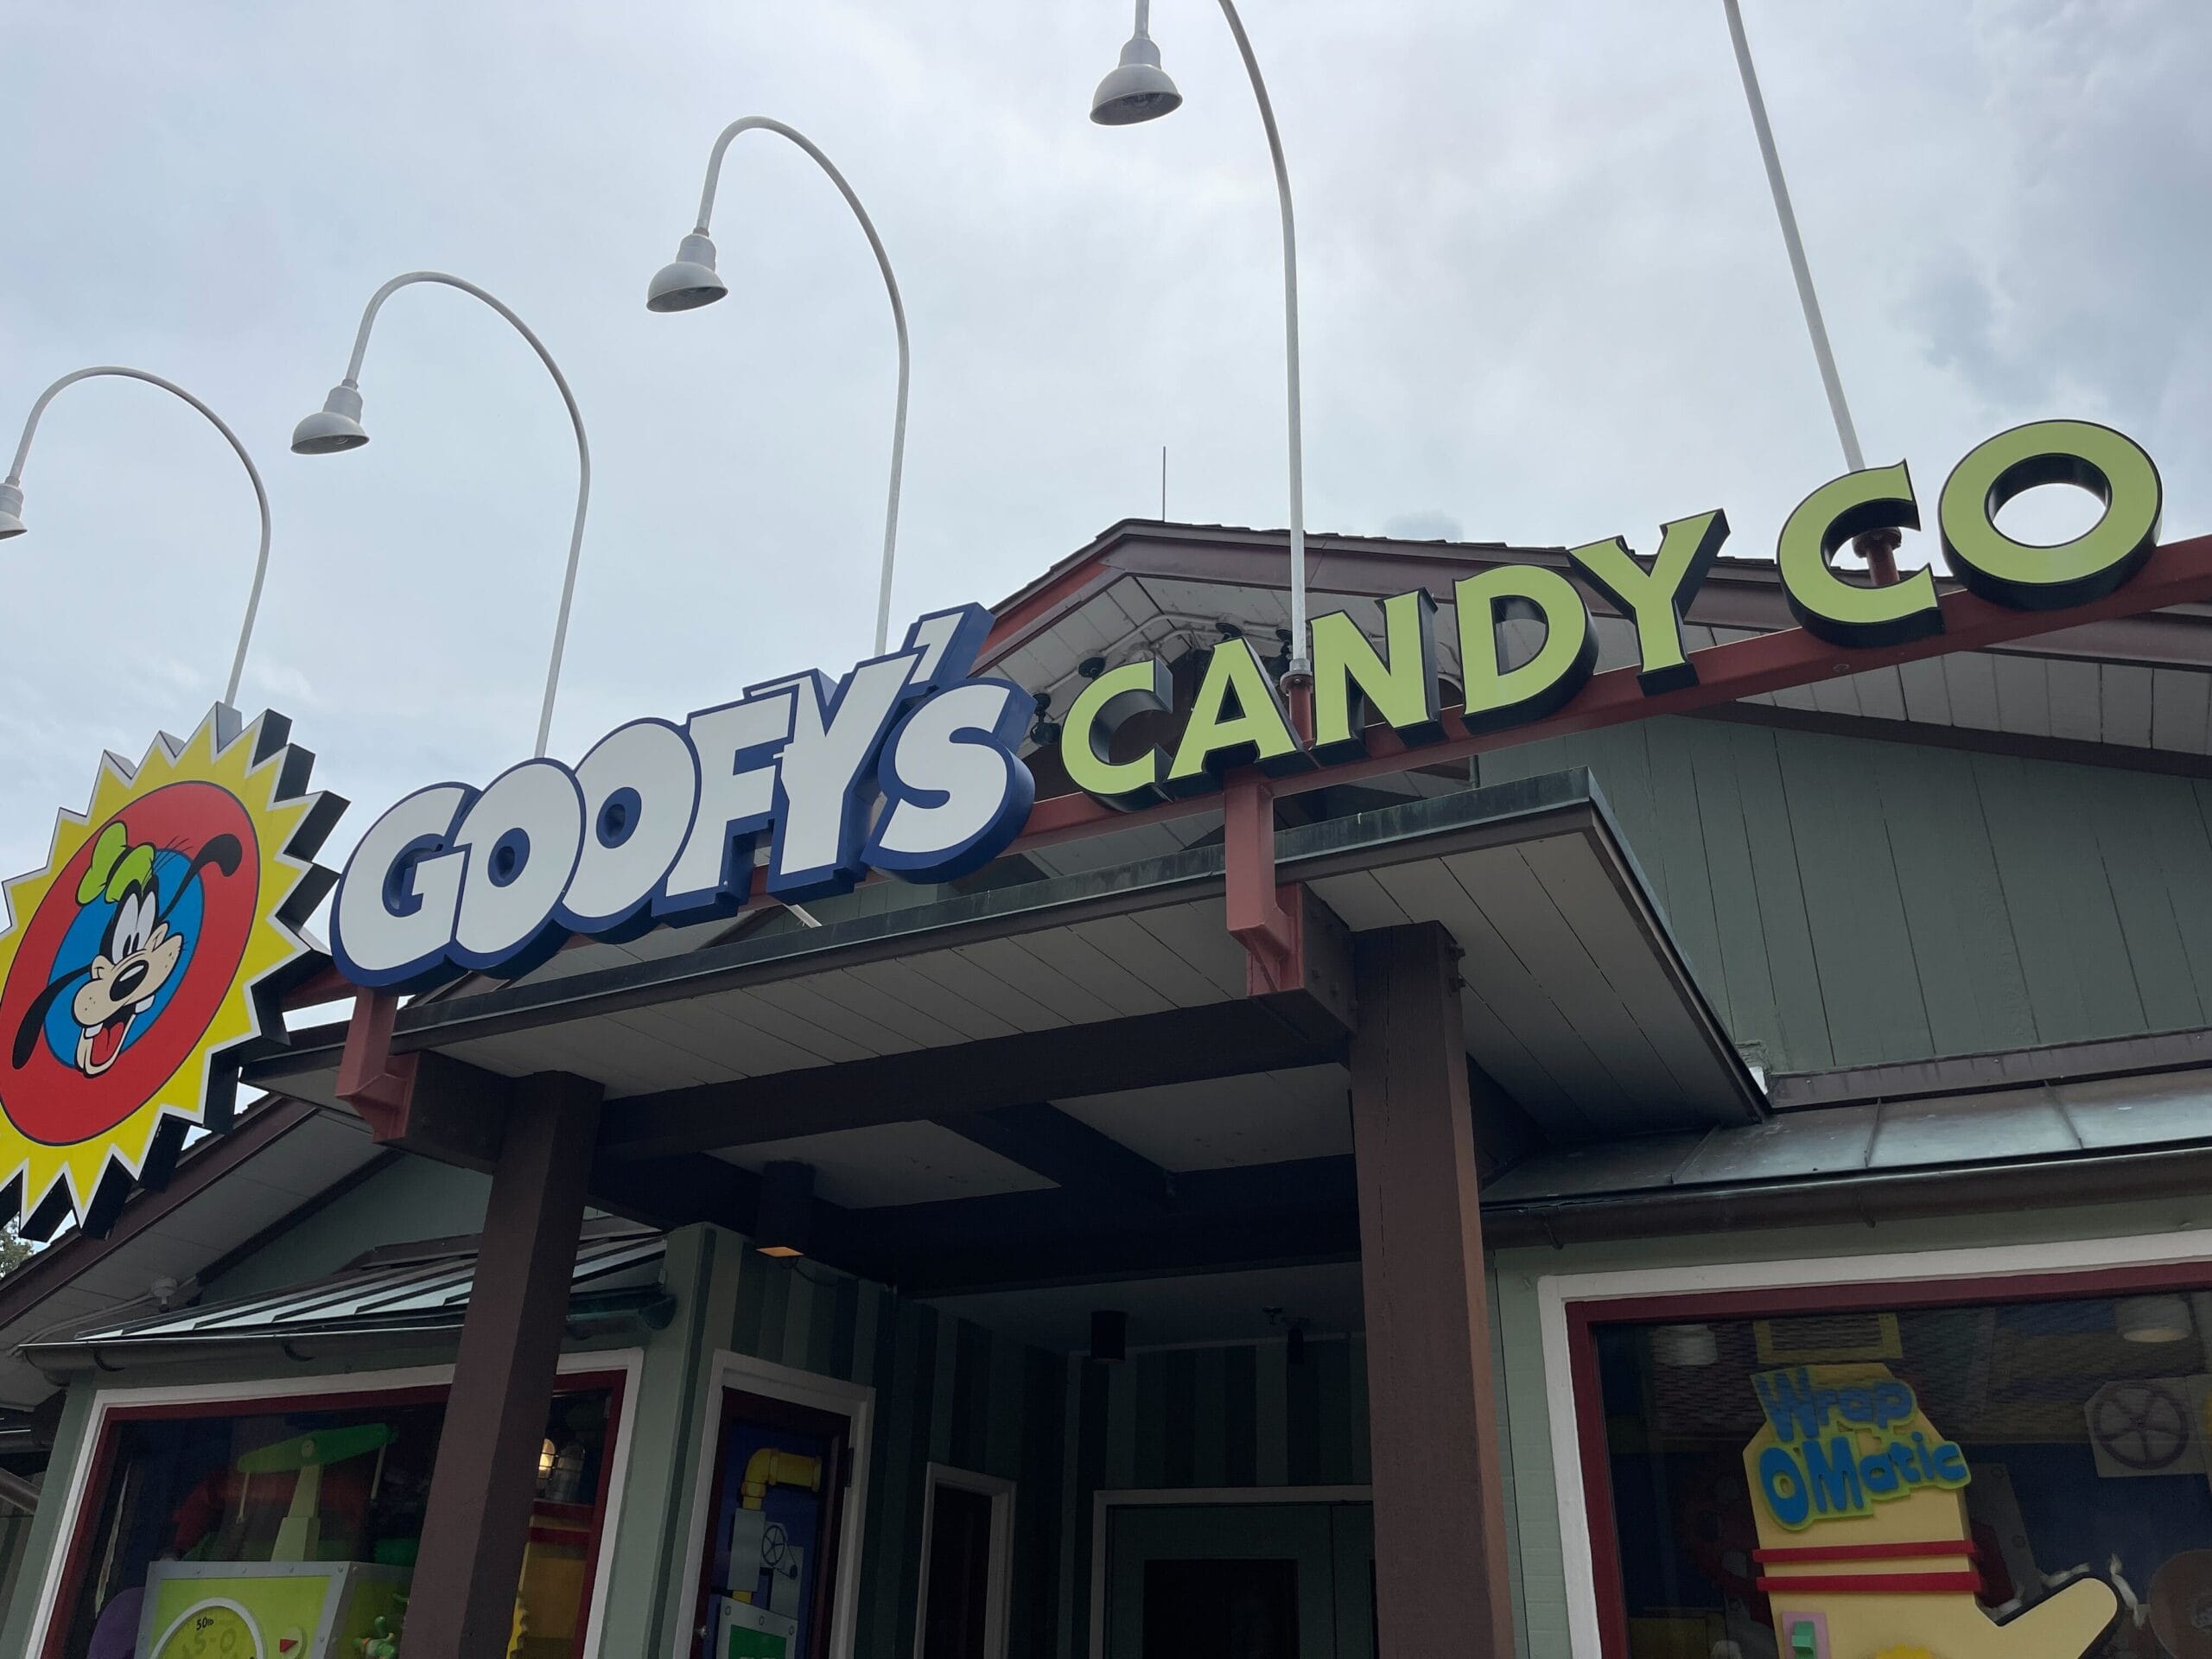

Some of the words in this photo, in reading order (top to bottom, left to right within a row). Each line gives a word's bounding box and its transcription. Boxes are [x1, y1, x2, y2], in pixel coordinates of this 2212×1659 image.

[334, 604, 1027, 983] GOOFY'S
[1060, 508, 1724, 802] CANDY
[1777, 419, 2163, 635] CO
[1755, 1367, 1912, 1441] Wrap
